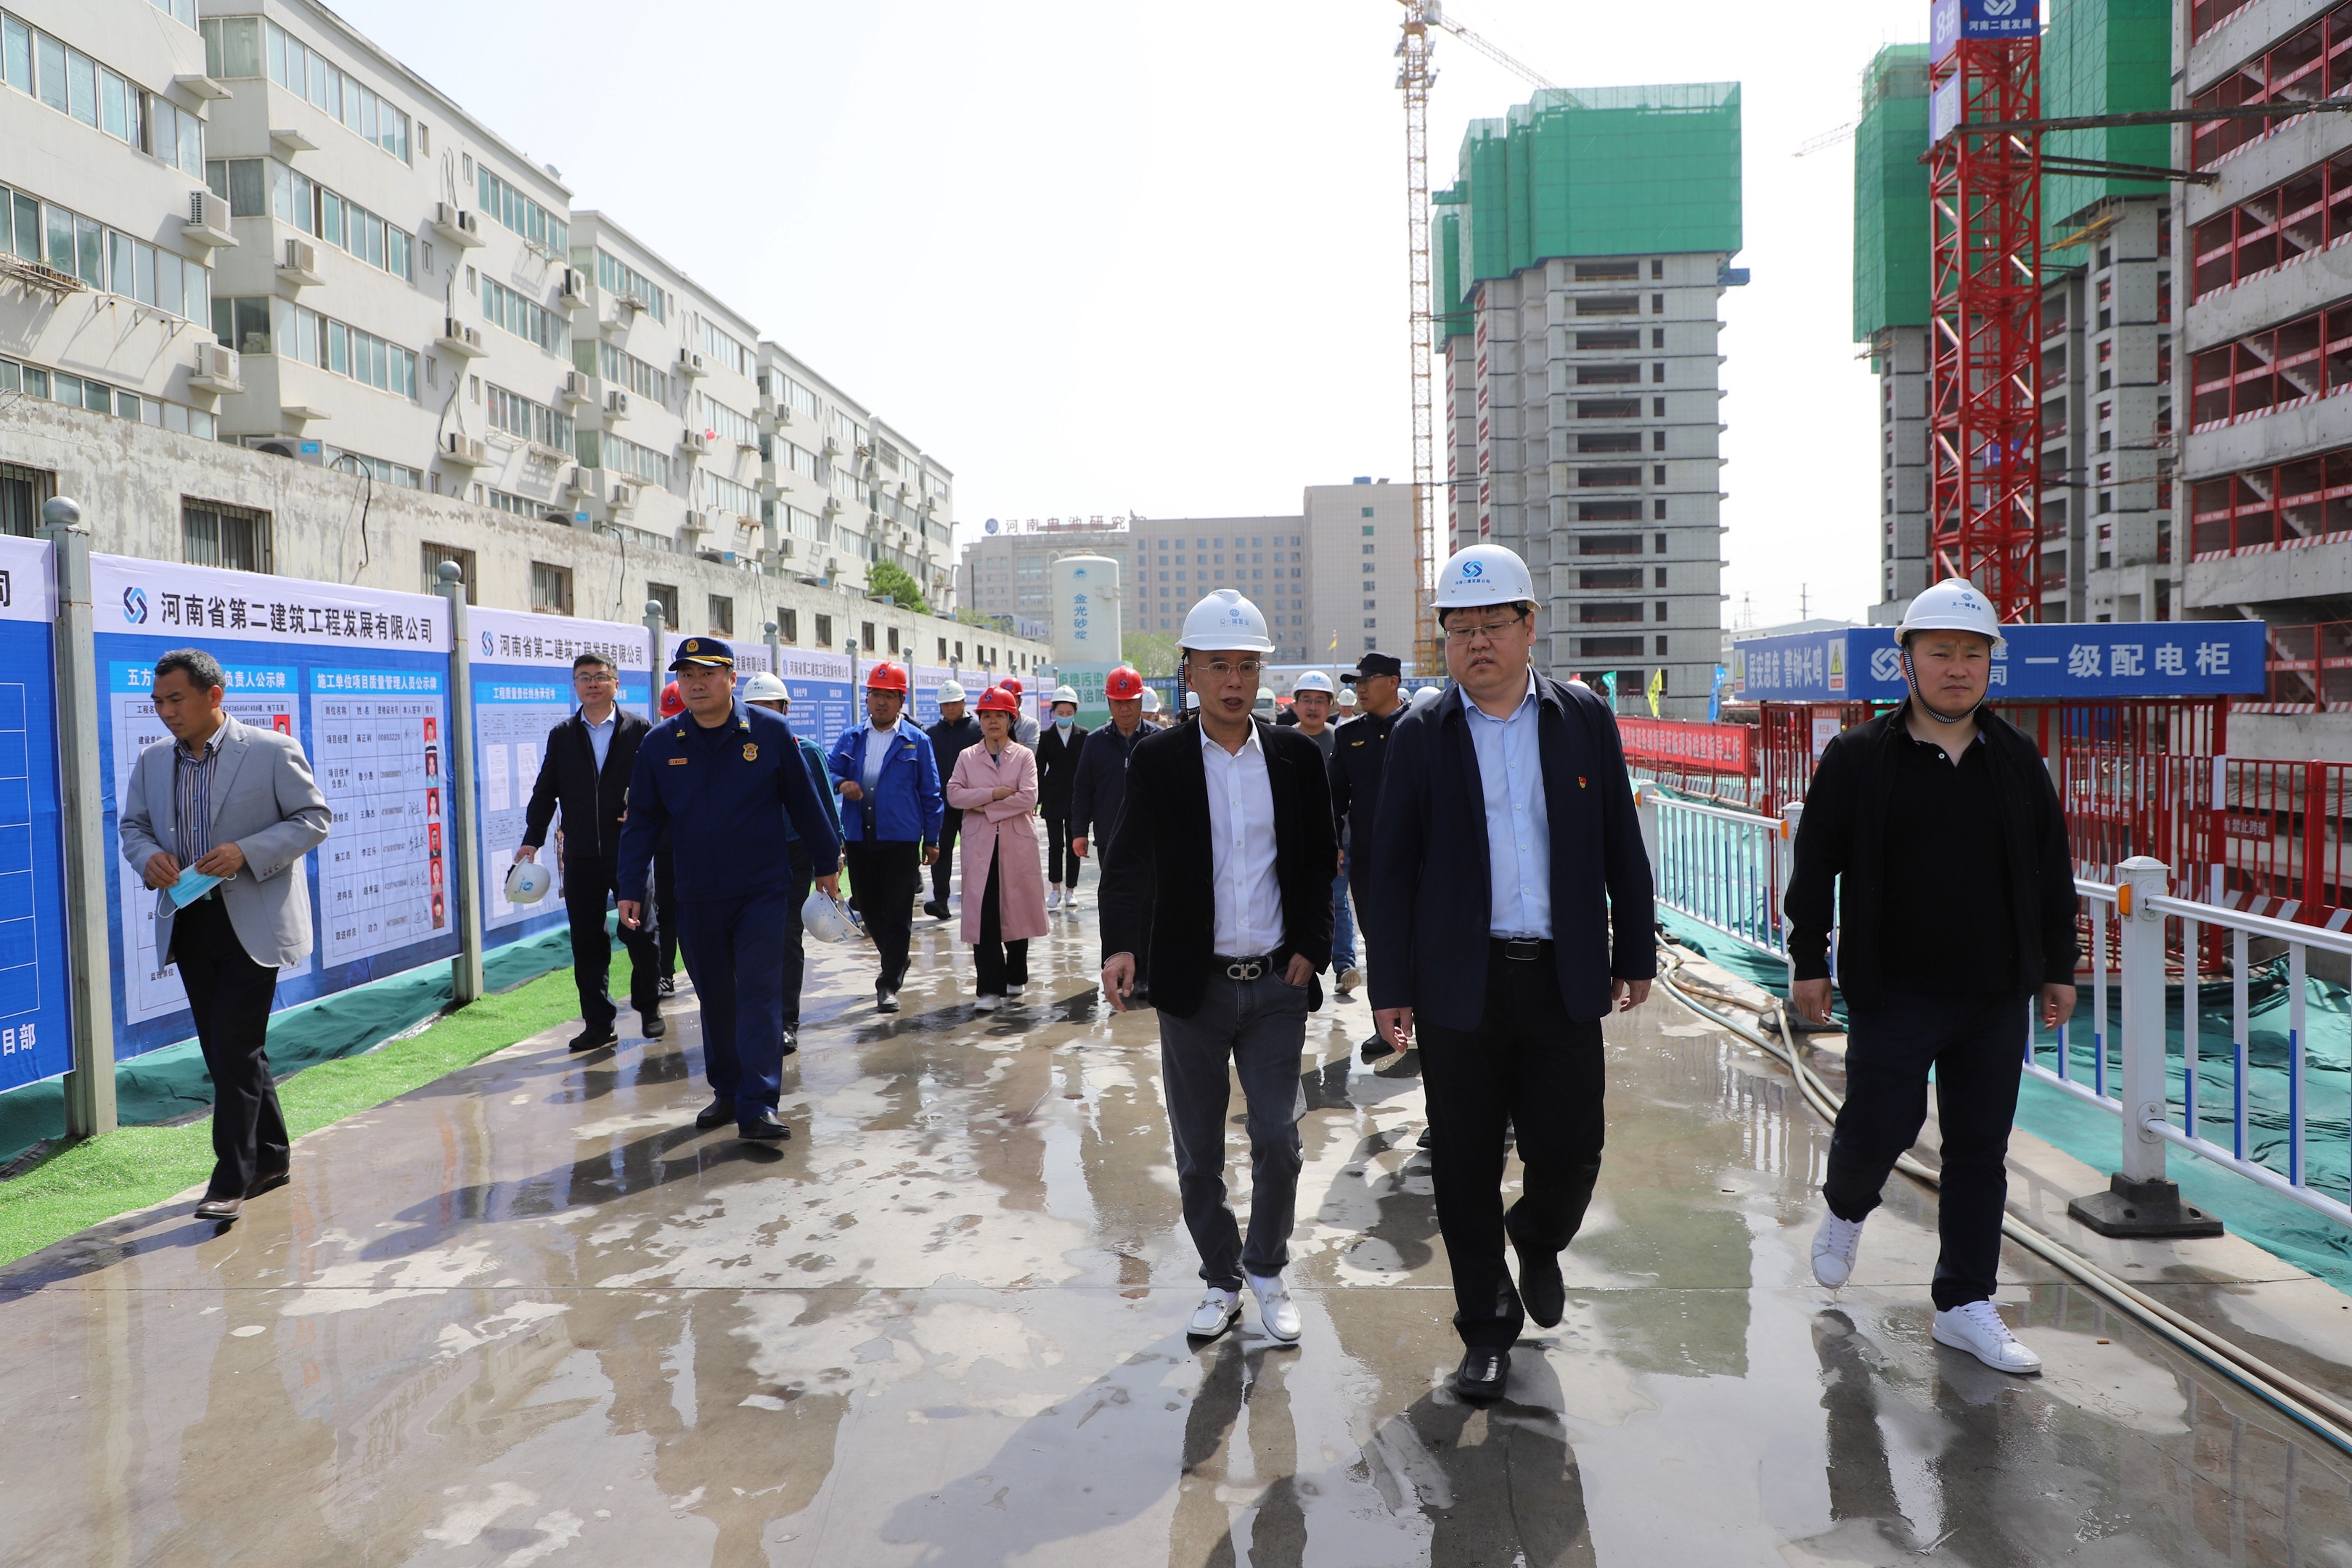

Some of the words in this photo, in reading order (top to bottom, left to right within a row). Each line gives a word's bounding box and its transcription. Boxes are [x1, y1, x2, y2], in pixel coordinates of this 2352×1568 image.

[1936, 1, 1955, 44] 8#
[1969, 18, 2032, 31] 河南二建发展
[160, 591, 433, 644] 河南省第二建筑工程发展有限公司
[1074, 594, 1087, 640] 金光砂浆
[499, 634, 642, 665] 河南省第二建筑工程发展有限公司
[1749, 650, 1781, 689] 居安思危
[1784, 645, 1824, 688] 警钟长鸣
[2025, 642, 2232, 679] 一级配电柜
[317, 673, 437, 690] 施工单位项目质量管理人员公示牌
[493, 687, 555, 701] 工程质量责任终身承诺书
[326, 706, 347, 715] 岗位名称
[377, 705, 399, 715] 资格证书号
[403, 706, 421, 714] 本人签字
[327, 735, 348, 744] 项目经理
[328, 768, 350, 777] 项目技术
[332, 779, 348, 789] 负责人
[333, 812, 349, 822] 质检员
[2232, 817, 2267, 837] 禁止跨越
[335, 852, 351, 862] 施工员
[362, 846, 377, 857] 李正乐
[337, 890, 353, 901] 资料员
[335, 928, 356, 941] 取送样员
[150, 968, 174, 981] 监理单位
